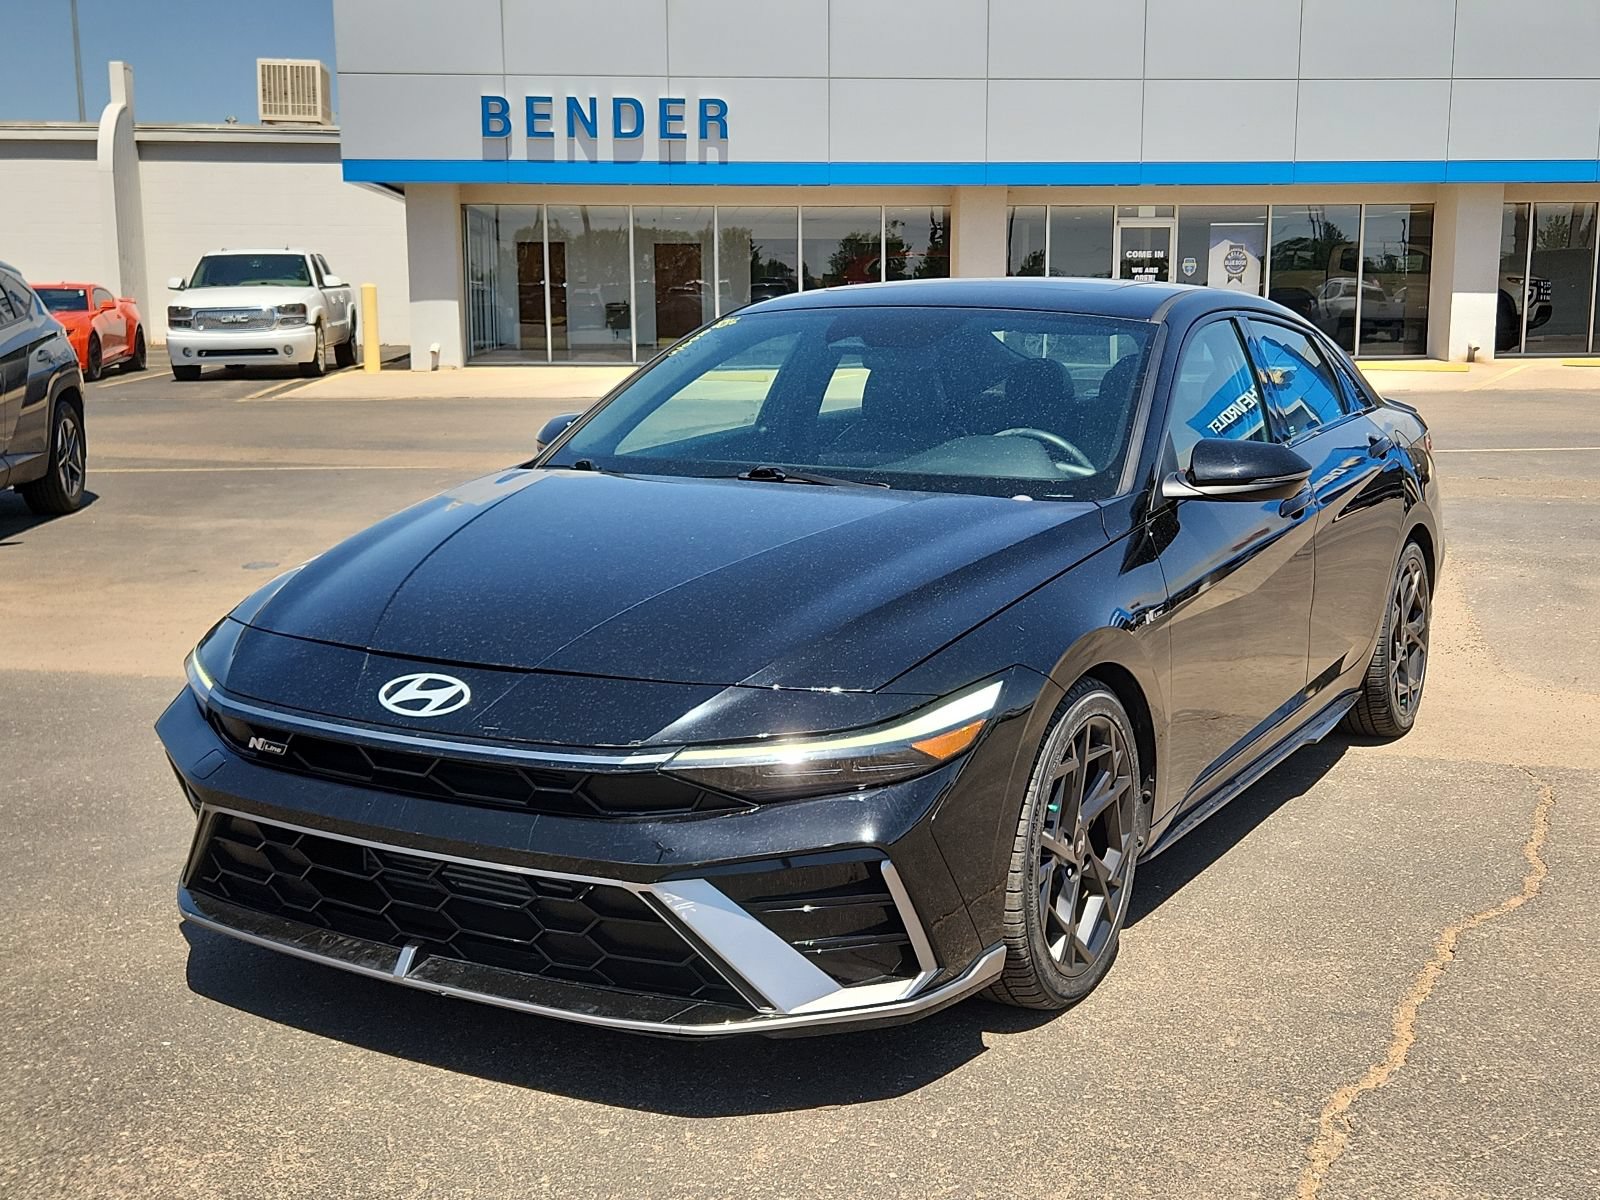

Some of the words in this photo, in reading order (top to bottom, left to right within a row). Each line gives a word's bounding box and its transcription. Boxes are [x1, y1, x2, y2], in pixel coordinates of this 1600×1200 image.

[481, 95, 728, 139] BENDER
[1126, 250, 1152, 258] COME
[1154, 250, 1164, 258] IN
[221, 314, 249, 322] GMC
